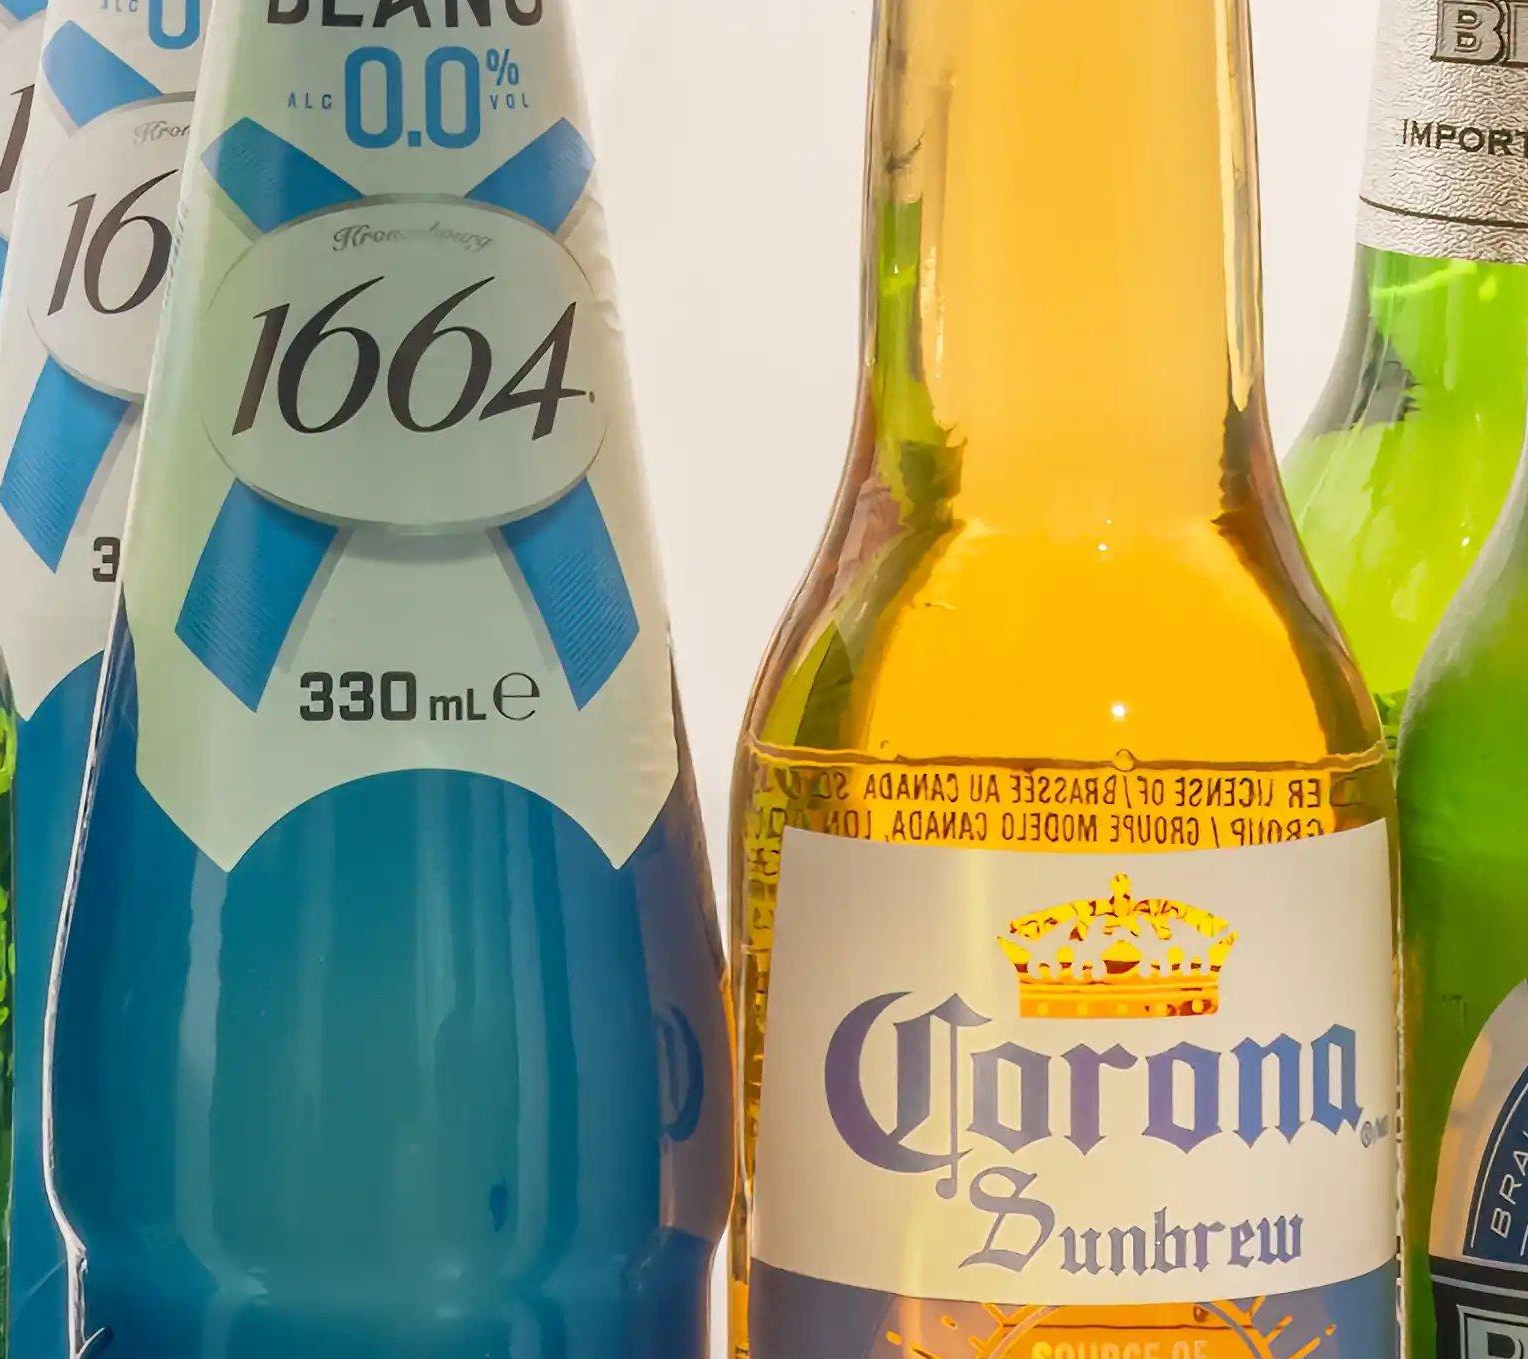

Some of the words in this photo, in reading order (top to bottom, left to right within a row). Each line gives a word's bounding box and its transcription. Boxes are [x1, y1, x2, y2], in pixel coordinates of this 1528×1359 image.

[288, 91, 333, 110] ALC
[344, 45, 520, 149] 0.0%
[488, 91, 530, 110] VOL
[231, 276, 587, 440] 1664
[299, 671, 417, 722] 330
[429, 685, 486, 722] mL
[824, 990, 1364, 1200] Corona
[957, 1164, 1306, 1278] Sunbrew
